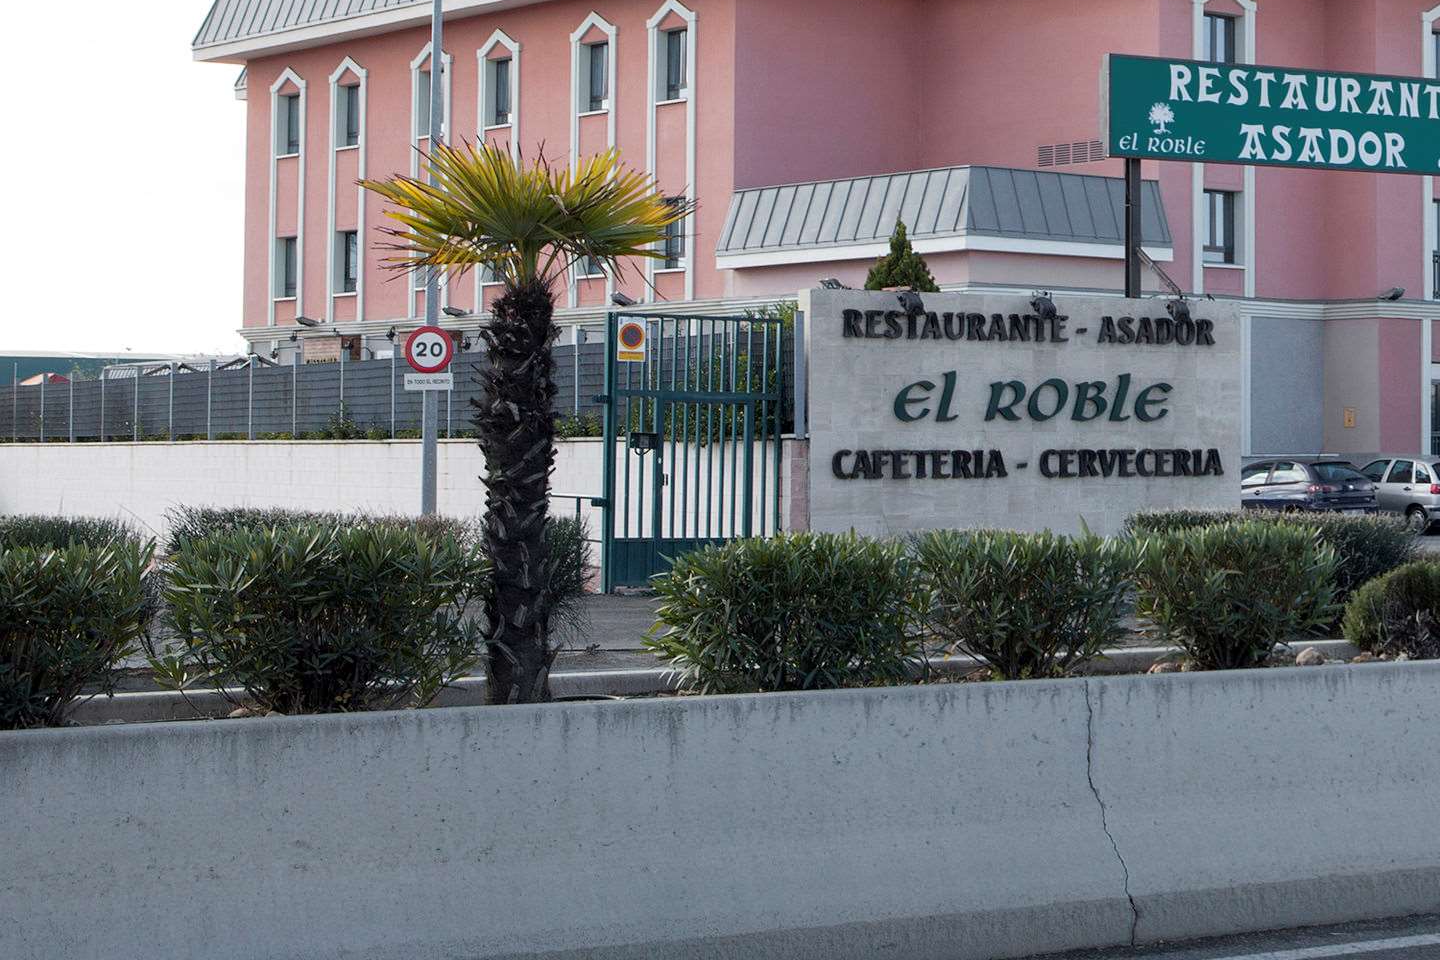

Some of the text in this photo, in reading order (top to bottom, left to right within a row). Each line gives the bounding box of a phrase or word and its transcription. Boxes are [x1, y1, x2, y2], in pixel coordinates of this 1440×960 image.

[1237, 123, 1408, 168] ASADOR
[842, 309, 1069, 342] RESTAURANTE
[1098, 316, 1216, 346] ASADOR
[416, 342, 442, 357] 20
[831, 449, 1008, 480] CAFETERIA
[1039, 448, 1225, 478] CERVECERIA
